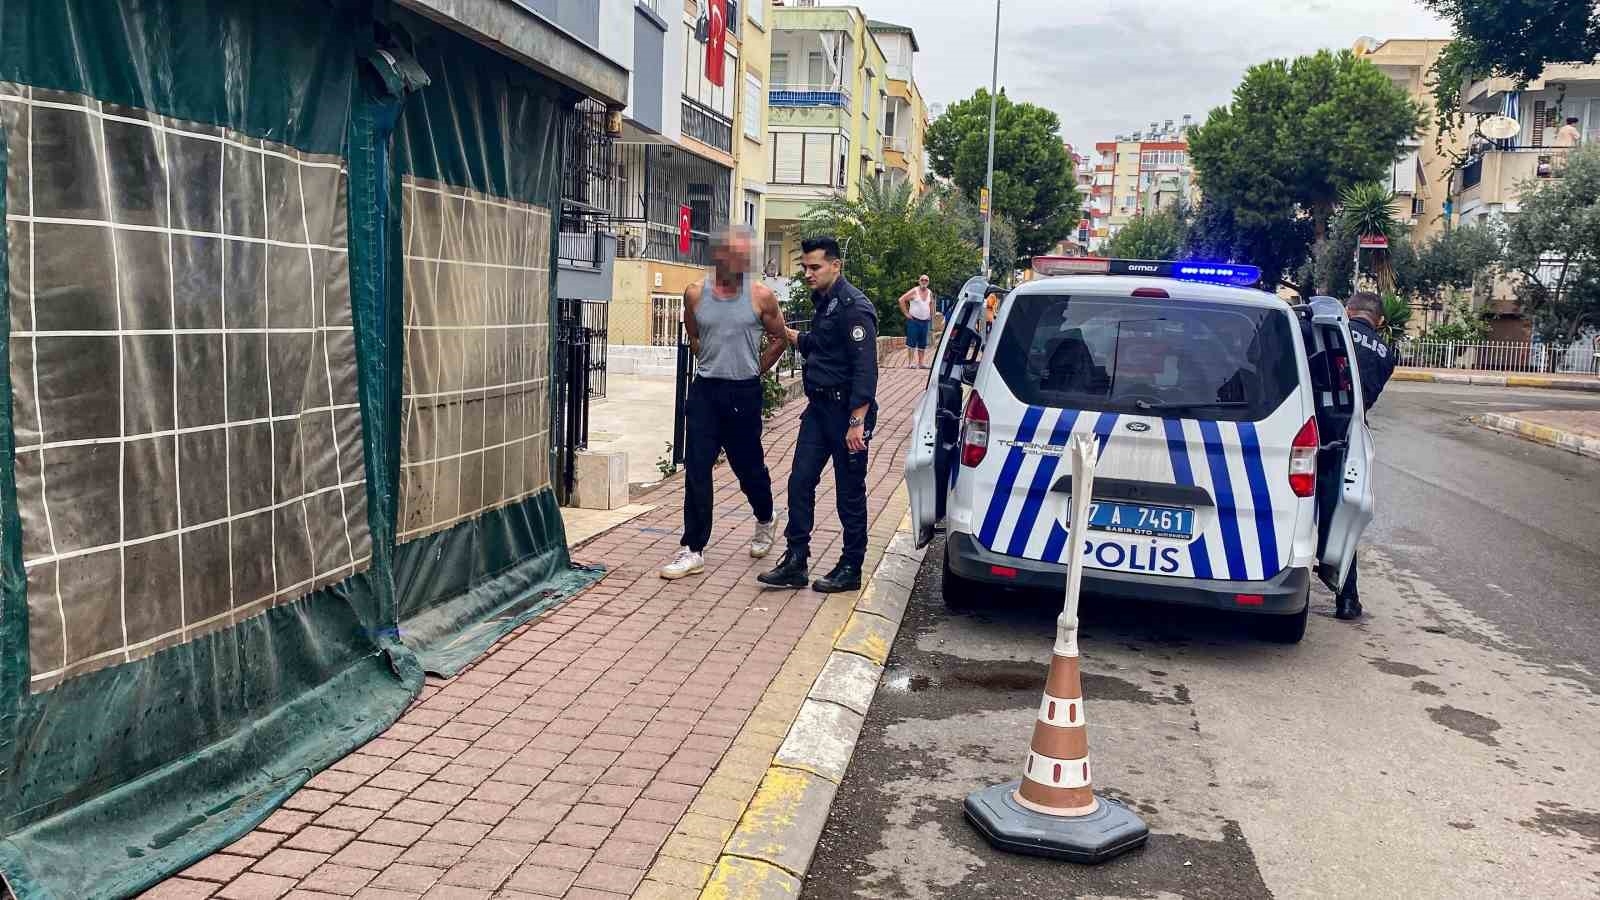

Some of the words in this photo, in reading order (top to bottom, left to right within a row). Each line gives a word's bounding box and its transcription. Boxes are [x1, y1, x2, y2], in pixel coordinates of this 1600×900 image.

[1352, 330, 1388, 358] OLIS
[1088, 503, 1100, 522] 7
[1111, 505, 1121, 525] A
[1138, 507, 1183, 531] 7461
